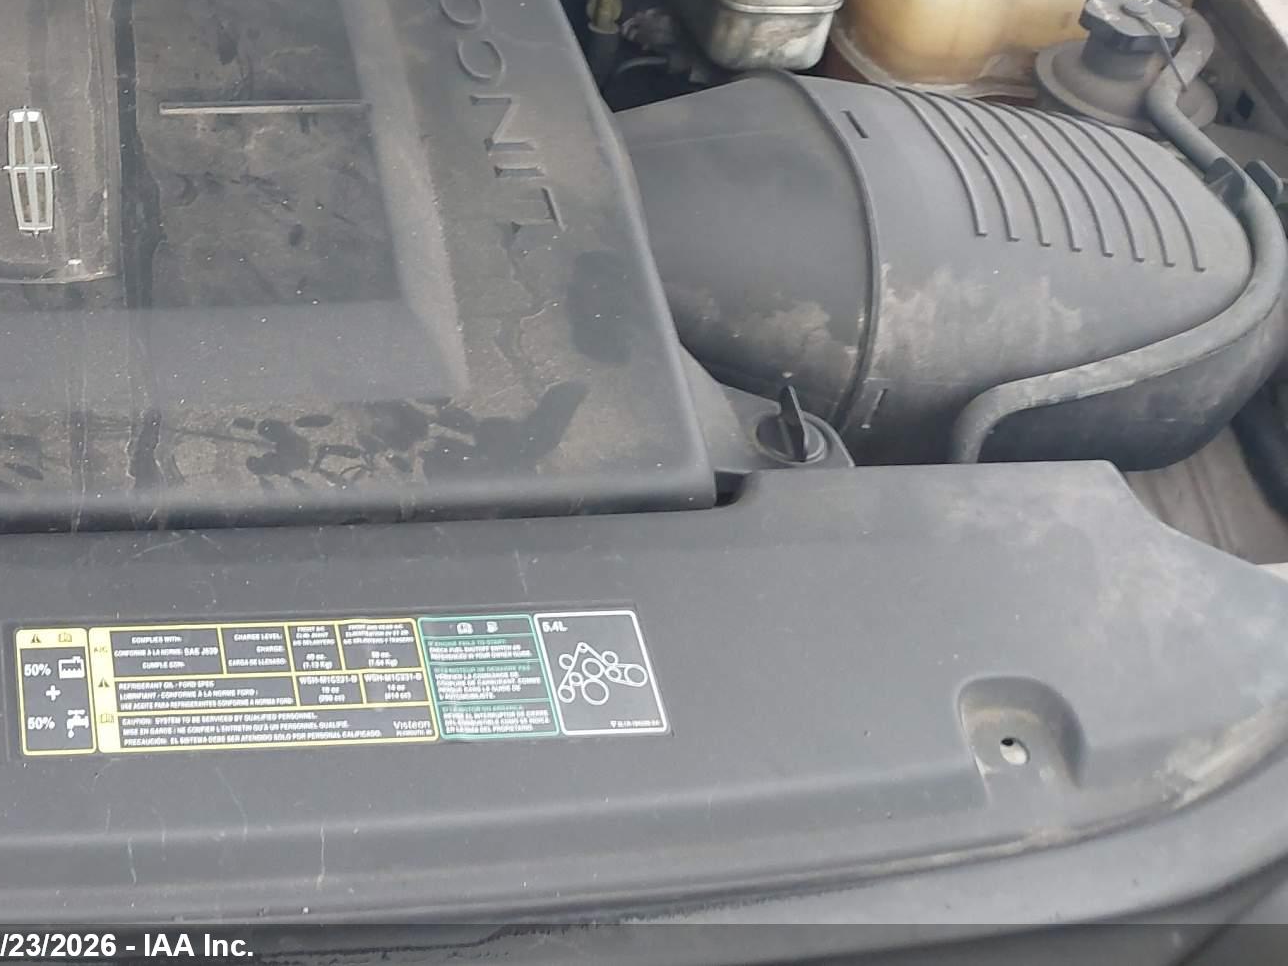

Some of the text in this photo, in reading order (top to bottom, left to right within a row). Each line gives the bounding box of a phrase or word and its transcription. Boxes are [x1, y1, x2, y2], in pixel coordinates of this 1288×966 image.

[23, 663, 51, 677] 50%
[27, 716, 55, 730] 50%
[393, 720, 430, 730] Visteon
